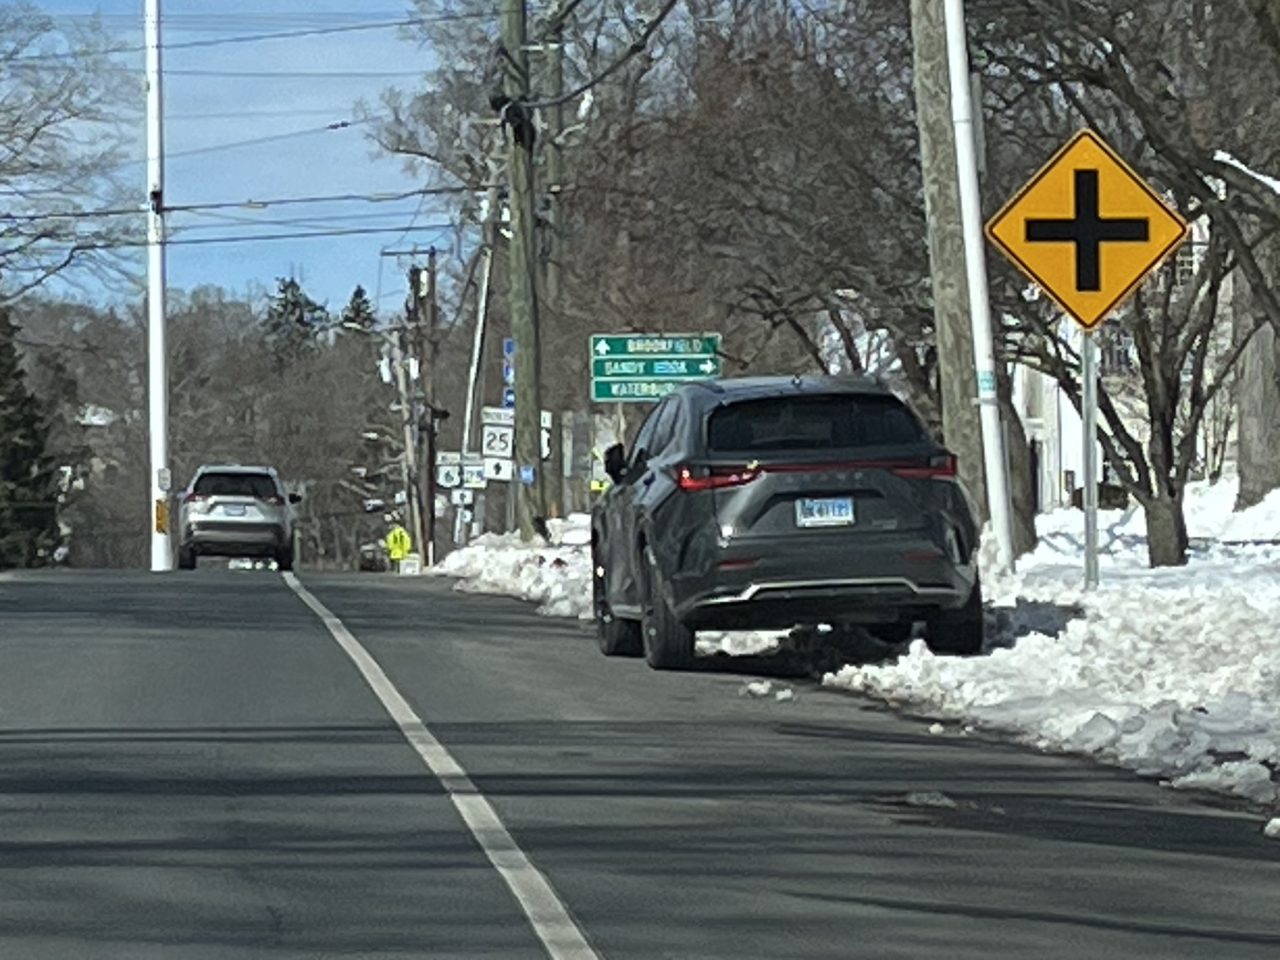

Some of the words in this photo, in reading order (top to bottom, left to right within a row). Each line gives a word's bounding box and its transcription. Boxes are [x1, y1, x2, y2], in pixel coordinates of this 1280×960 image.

[605, 361, 645, 375] SANDY
[486, 432, 509, 451] 25
[443, 470, 455, 483] 6
